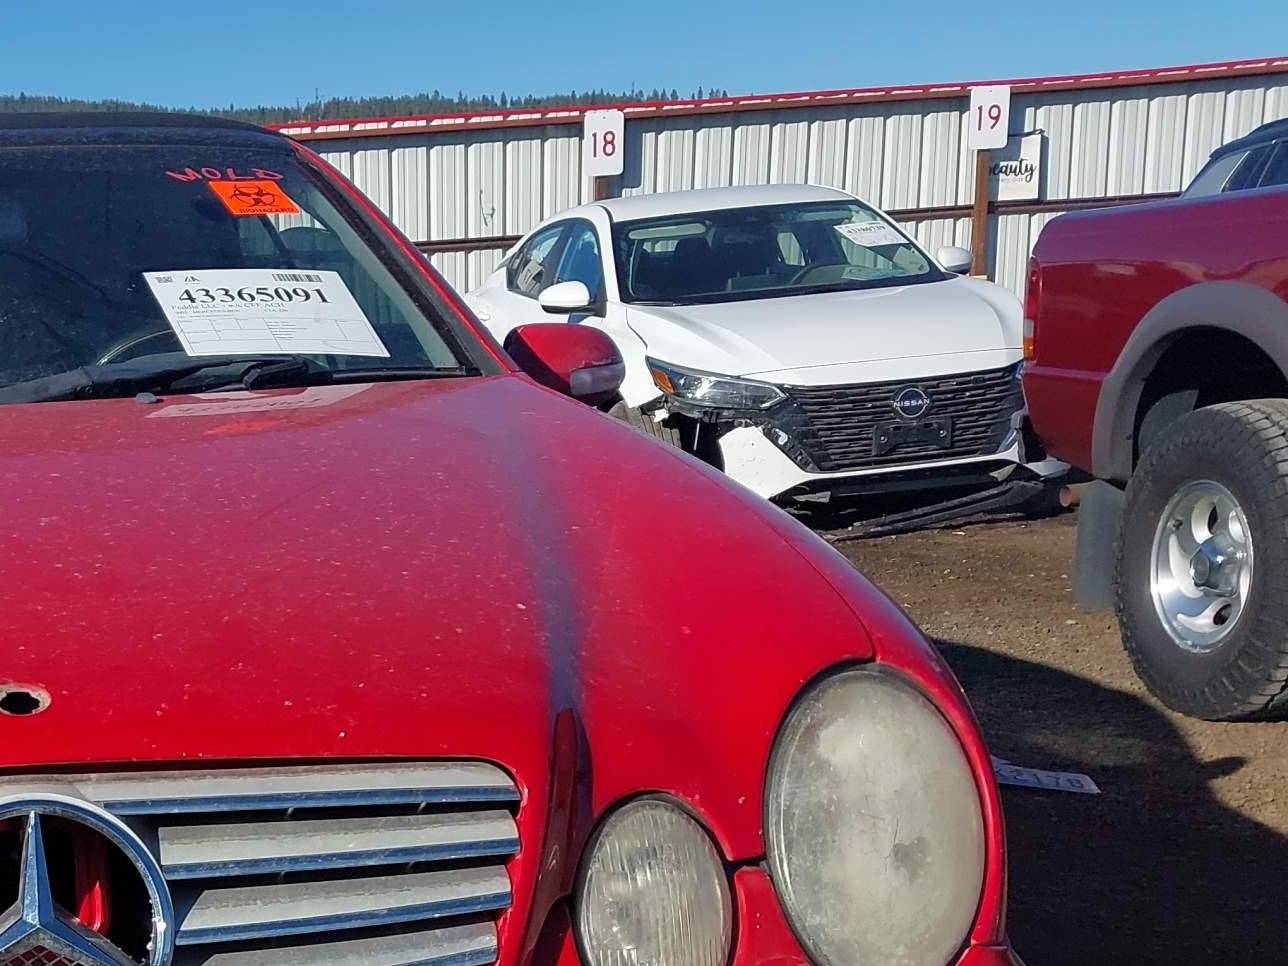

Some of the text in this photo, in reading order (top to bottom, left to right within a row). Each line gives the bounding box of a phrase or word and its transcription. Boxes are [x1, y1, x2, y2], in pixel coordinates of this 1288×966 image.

[978, 104, 1001, 131] 19
[592, 130, 616, 157] 18
[166, 167, 284, 182] MOLD
[178, 287, 332, 304] 43365091
[893, 398, 930, 409] NISSAN
